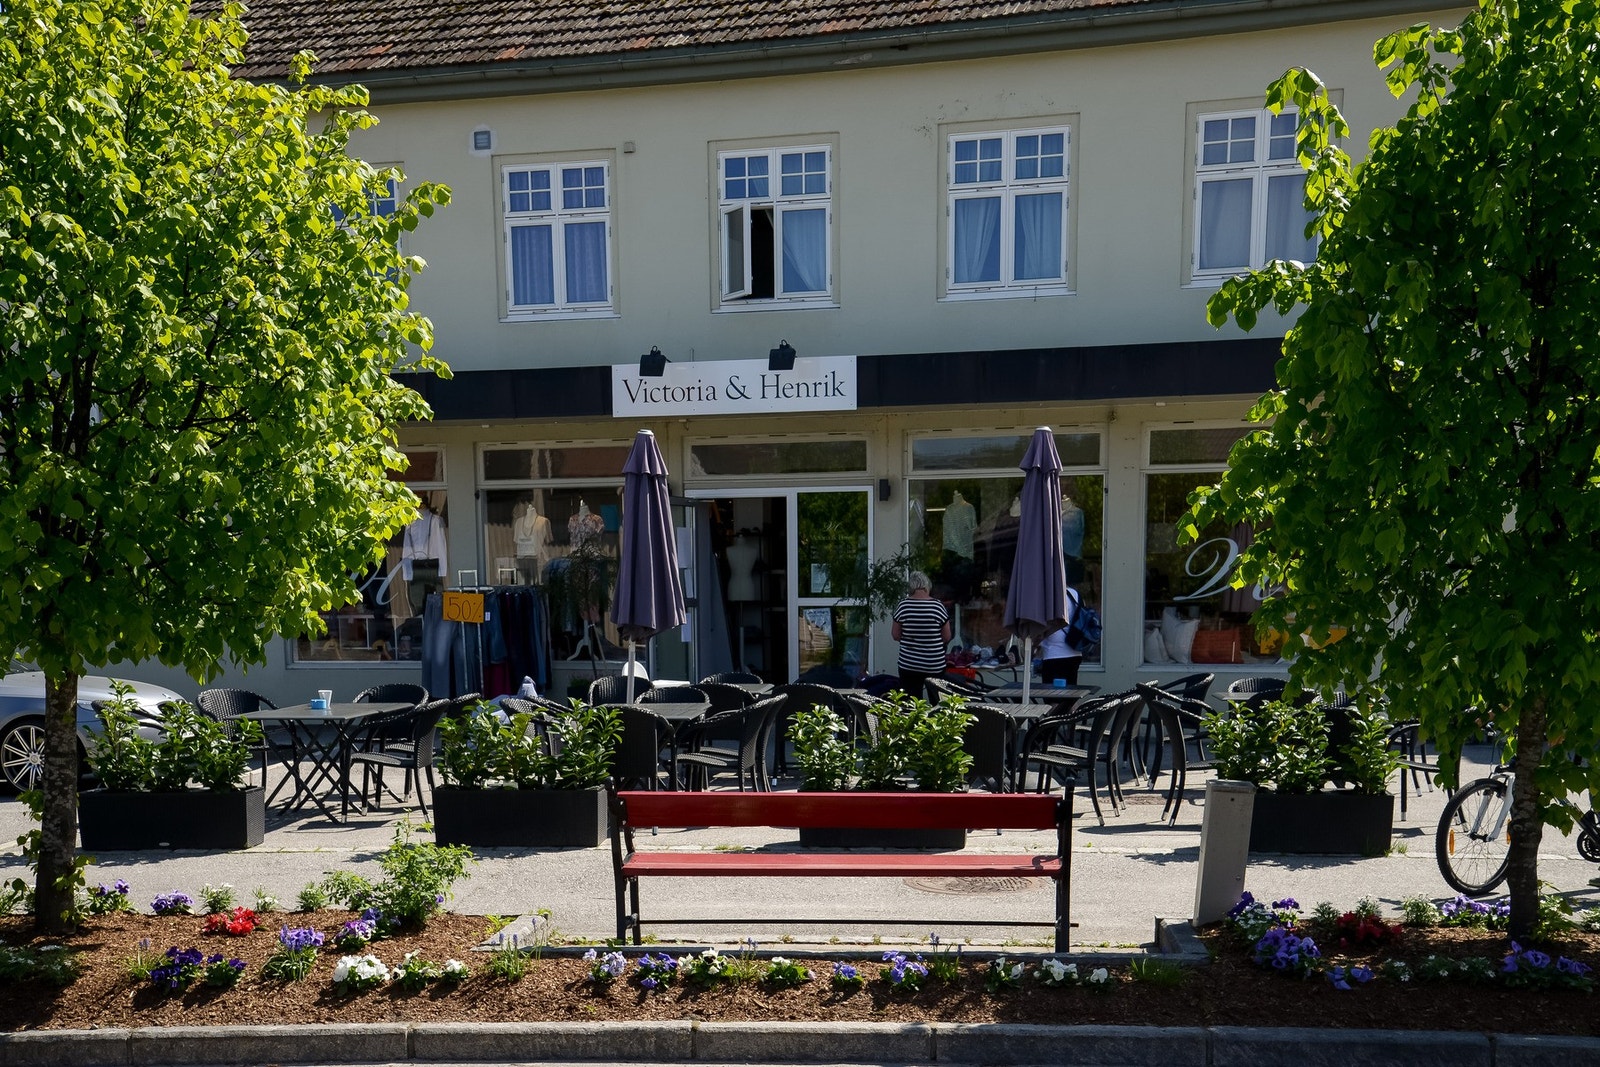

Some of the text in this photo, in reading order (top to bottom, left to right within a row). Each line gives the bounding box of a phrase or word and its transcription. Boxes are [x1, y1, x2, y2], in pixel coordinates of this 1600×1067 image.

[622, 370, 847, 404] Victoria & Henrik
[448, 597, 483, 621] 50%
